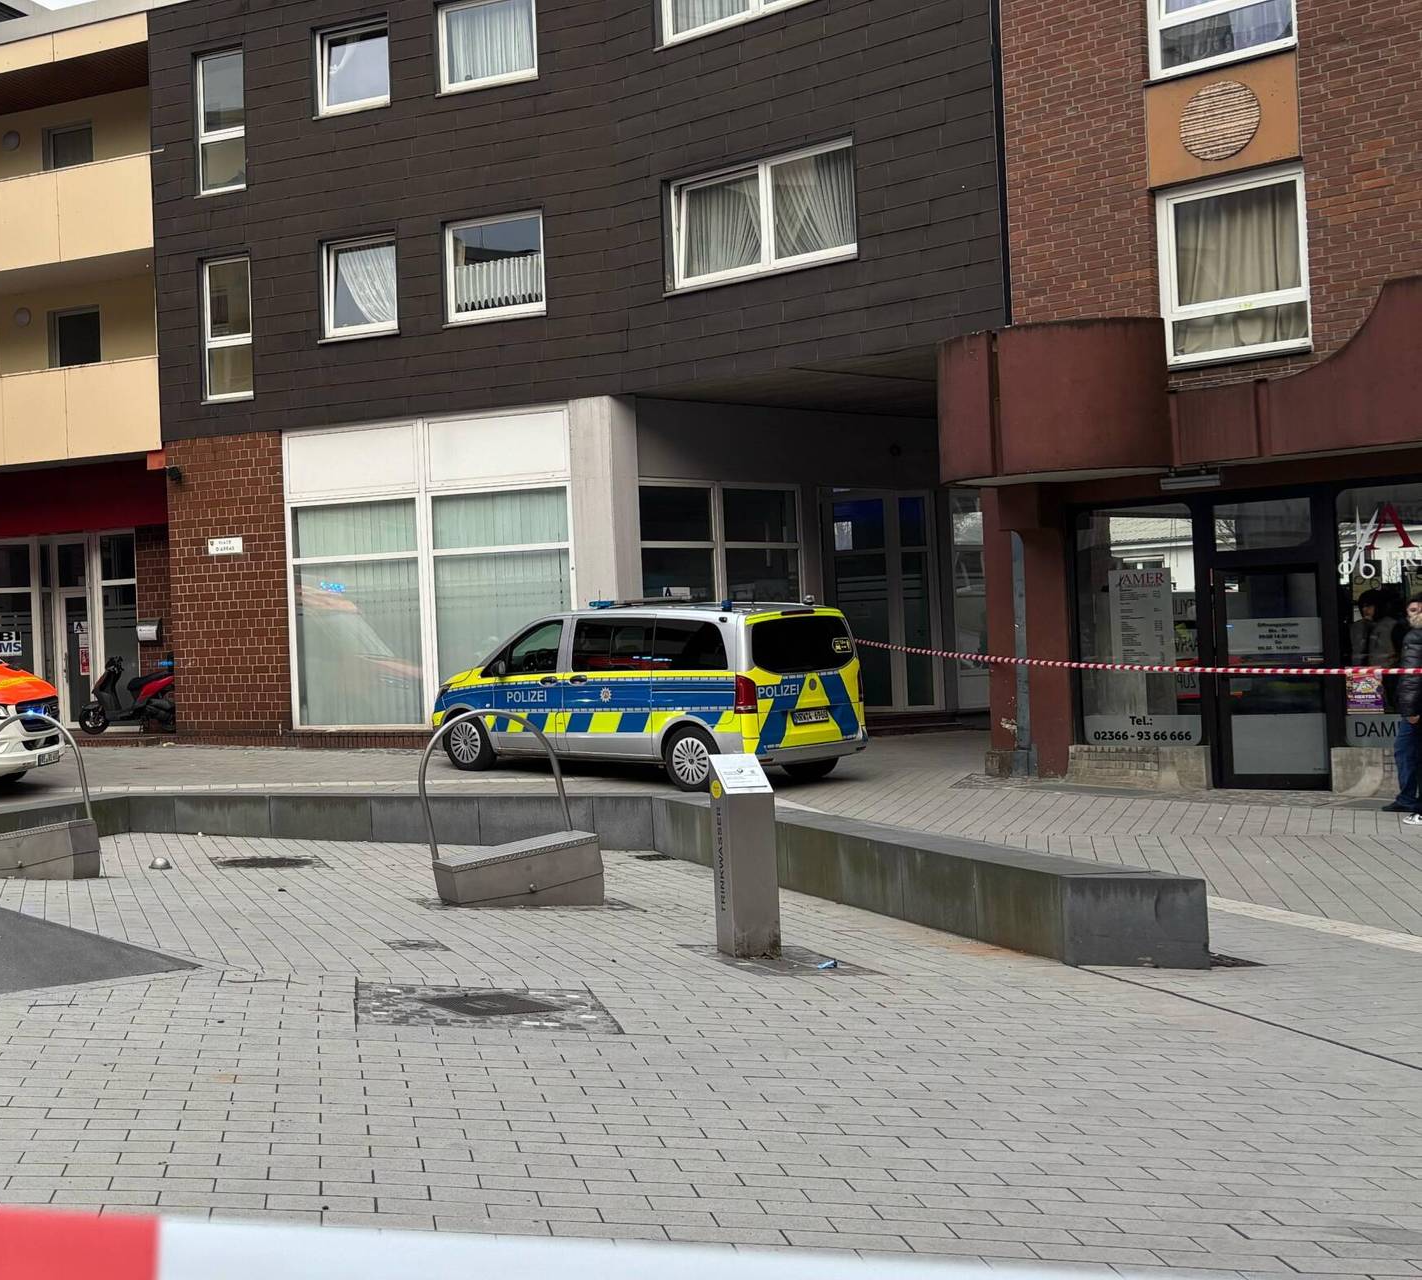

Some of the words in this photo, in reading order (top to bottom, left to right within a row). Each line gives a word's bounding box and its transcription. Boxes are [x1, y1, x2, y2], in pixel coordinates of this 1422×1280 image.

[0, 631, 20, 641] BI
[0, 642, 21, 653] MS
[506, 690, 547, 703] POLIZEI
[758, 684, 799, 698] POLIZEI
[1130, 716, 1153, 726] Tel.:
[1094, 730, 1129, 741] 02366
[1137, 730, 1151, 741] 93
[1153, 730, 1168, 741] 66
[1170, 730, 1192, 741] 666
[1354, 721, 1401, 738] DAM
[716, 807, 726, 912] TRINKWASSER
